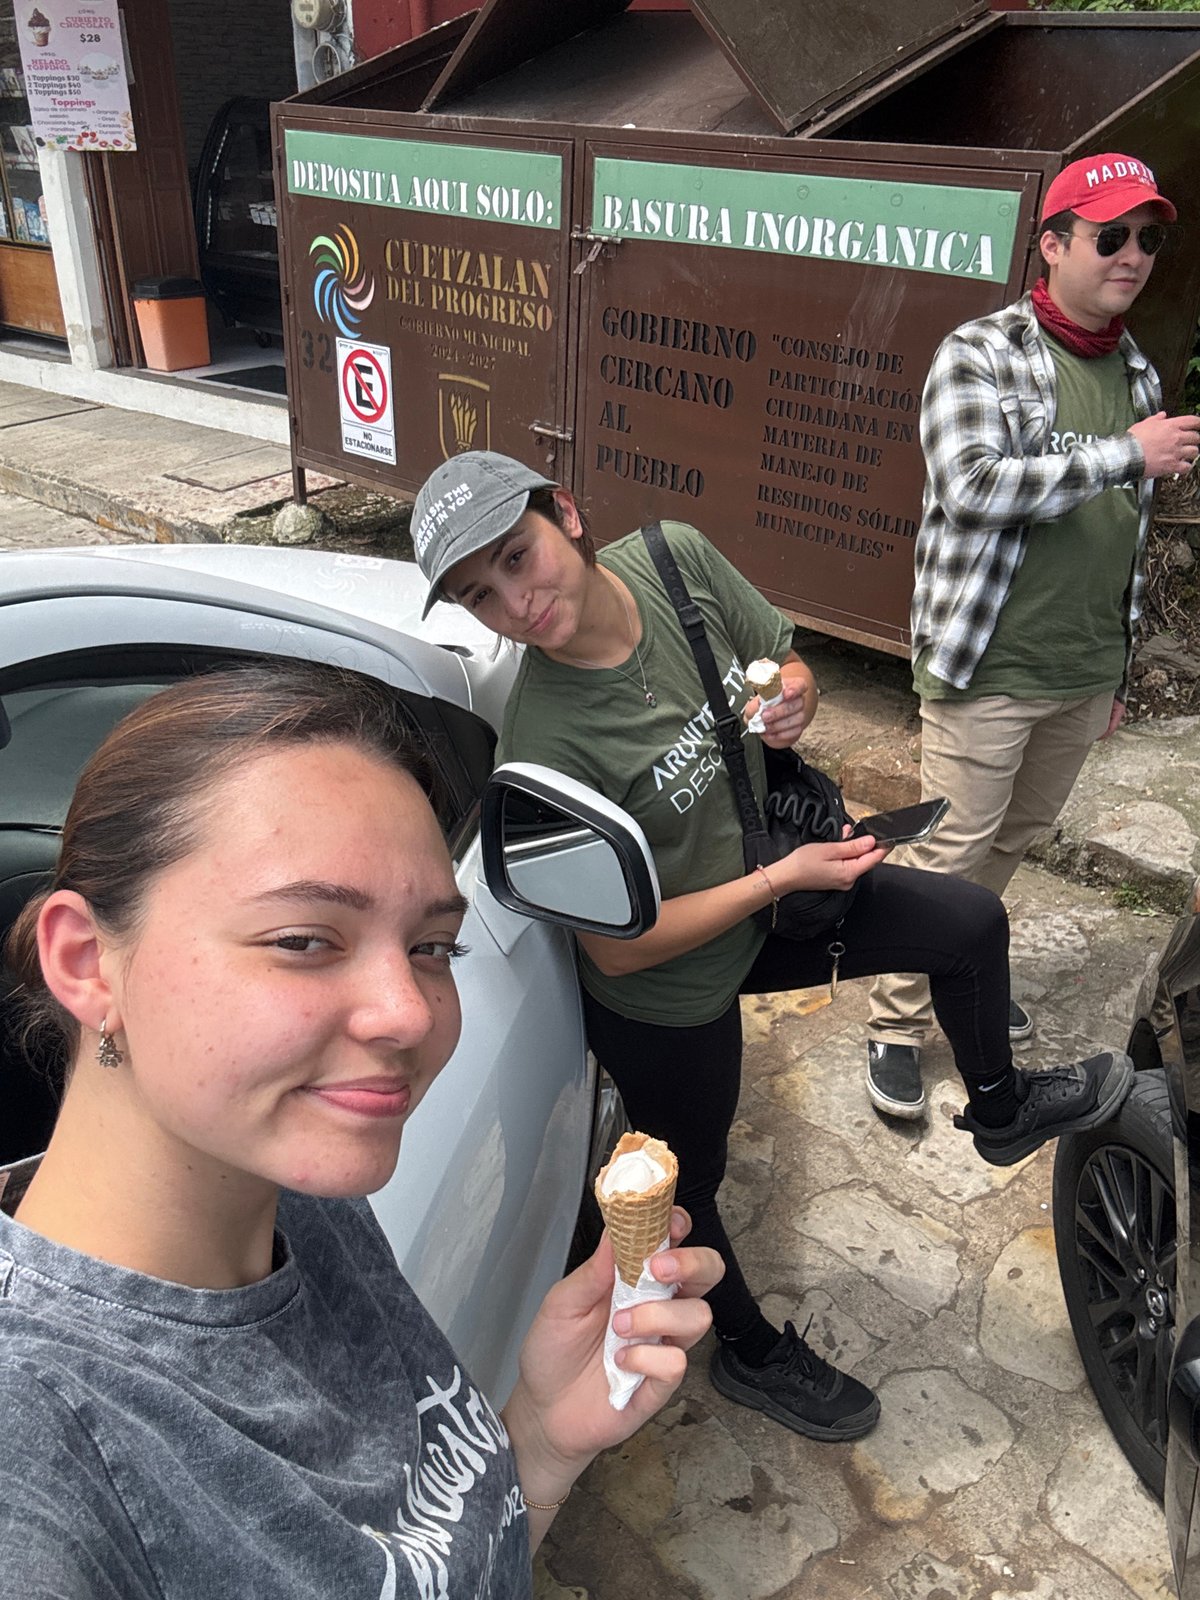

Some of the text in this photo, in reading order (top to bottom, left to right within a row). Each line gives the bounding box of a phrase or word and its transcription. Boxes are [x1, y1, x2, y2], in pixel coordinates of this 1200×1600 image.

[80, 34, 101, 43] $28
[32, 75, 66, 83] Toppings
[35, 89, 68, 97] Toppings
[51, 98, 96, 108] Toppings
[293, 159, 553, 225] DEPOSITA AQUI SOLO:
[602, 194, 994, 275] BASURA INORGANICA
[384, 238, 551, 299] CUETZALAN
[386, 274, 552, 332] DEL PROGRESO
[301, 331, 333, 374] 32
[400, 315, 531, 357] GOBIERNO MUNICIPAL
[602, 306, 756, 363] GOBIERNO
[771, 334, 904, 375] "CONSEJO DE
[431, 344, 458, 363] 2024
[467, 351, 496, 370] 2027
[600, 354, 734, 410] CERCANO
[363, 431, 373, 441] NO
[599, 401, 632, 433] AL
[766, 398, 914, 443] CIUDADANA EN
[345, 437, 393, 457] ESTACIONARSE
[764, 426, 883, 467] MATERIA DE
[444, 482, 470, 501] THE
[596, 445, 705, 498] PUEBLO
[760, 453, 869, 493] MANEJO DE
[436, 510, 449, 525] IN
[447, 490, 473, 512] YOU
[757, 484, 919, 538] RESIDUOS SÓLID
[755, 511, 894, 559] MUNICIPALES"
